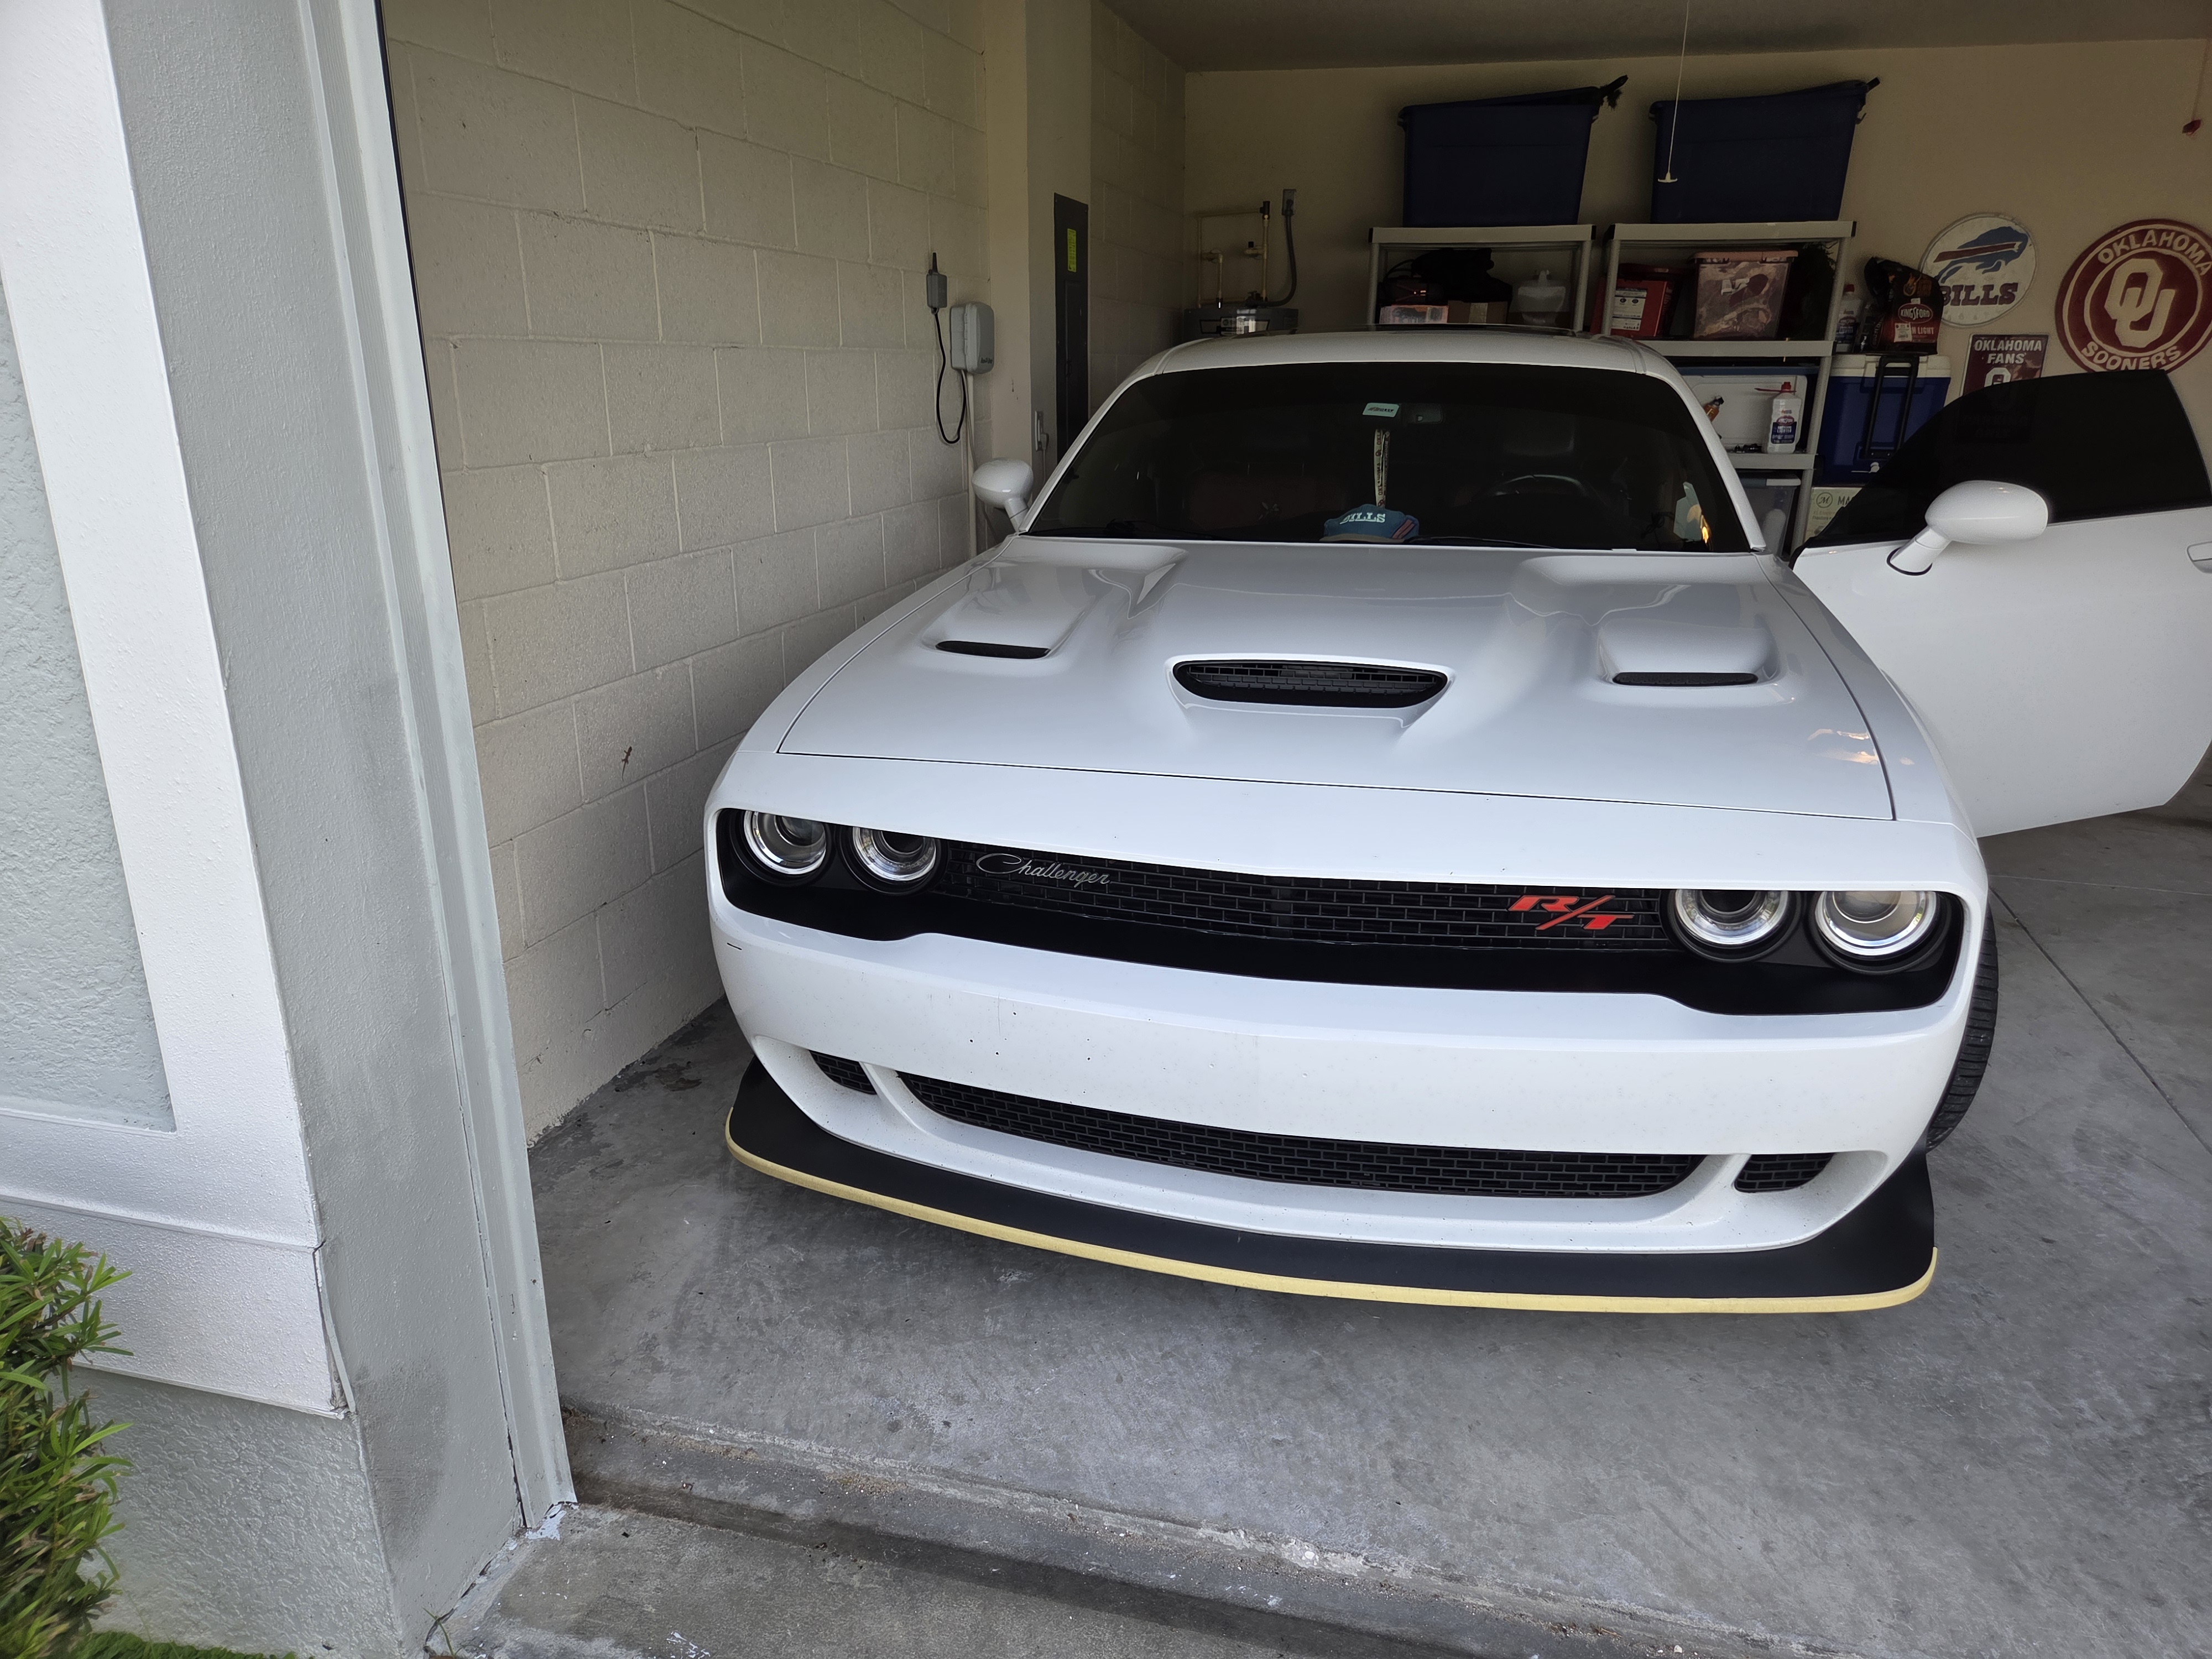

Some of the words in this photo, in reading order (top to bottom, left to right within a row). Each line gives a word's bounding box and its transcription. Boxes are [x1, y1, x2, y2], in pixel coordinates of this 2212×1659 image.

[2098, 229, 2212, 276] OKLAHOMA
[1901, 307, 1930, 320] KINGSFORD
[1917, 326, 1934, 335] LIGHT
[1974, 340, 2042, 351] OKLAHOMA
[2081, 341, 2181, 371] SOONERS
[976, 853, 1111, 888] Challenger
[1507, 895, 1635, 931] R/T
